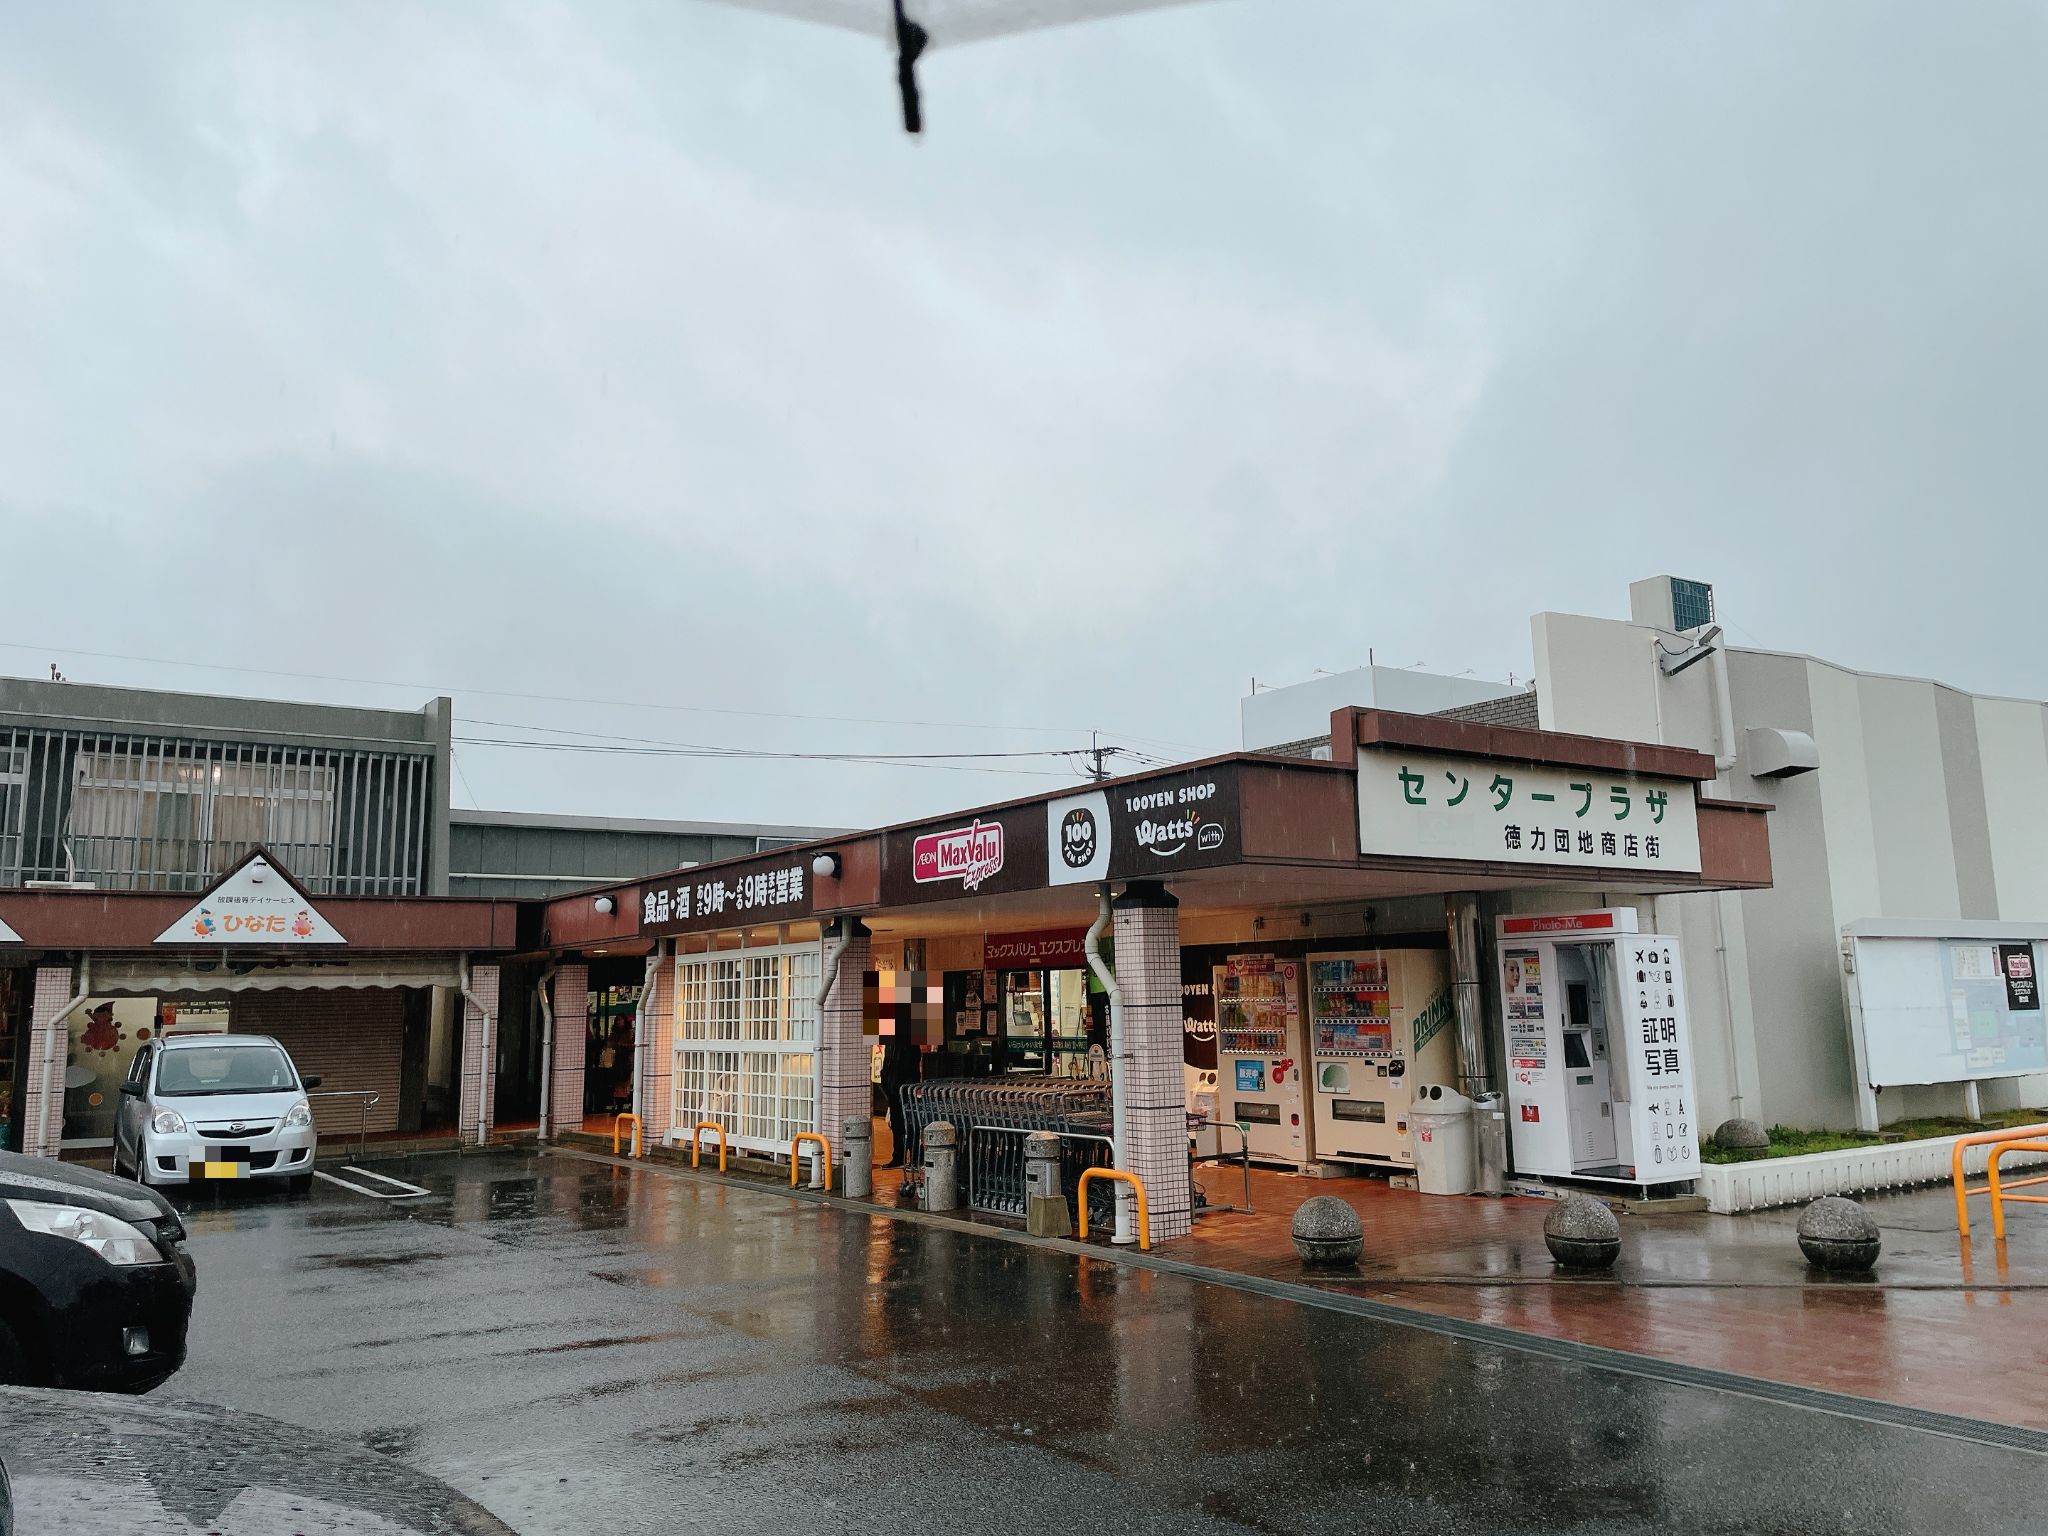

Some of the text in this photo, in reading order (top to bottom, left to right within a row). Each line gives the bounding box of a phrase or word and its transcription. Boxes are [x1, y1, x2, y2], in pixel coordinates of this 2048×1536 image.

[1126, 783, 1216, 813] 100YEN SHOP
[1398, 766, 1668, 824] センタープラザ
[940, 822, 997, 868] MaxValu
[1065, 821, 1092, 843] 100
[1135, 819, 1193, 846] Watts
[1201, 830, 1220, 844] with
[1504, 824, 1660, 858] 徳力団地商店街
[1064, 840, 1094, 864] YEN SHOP
[964, 857, 999, 888] Express
[644, 886, 690, 924] 食品・酒
[224, 915, 286, 932] ひなた
[986, 942, 1037, 958] マックスバリュ
[1642, 1017, 1677, 1043] 証明
[1645, 1048, 1680, 1075] 写真
